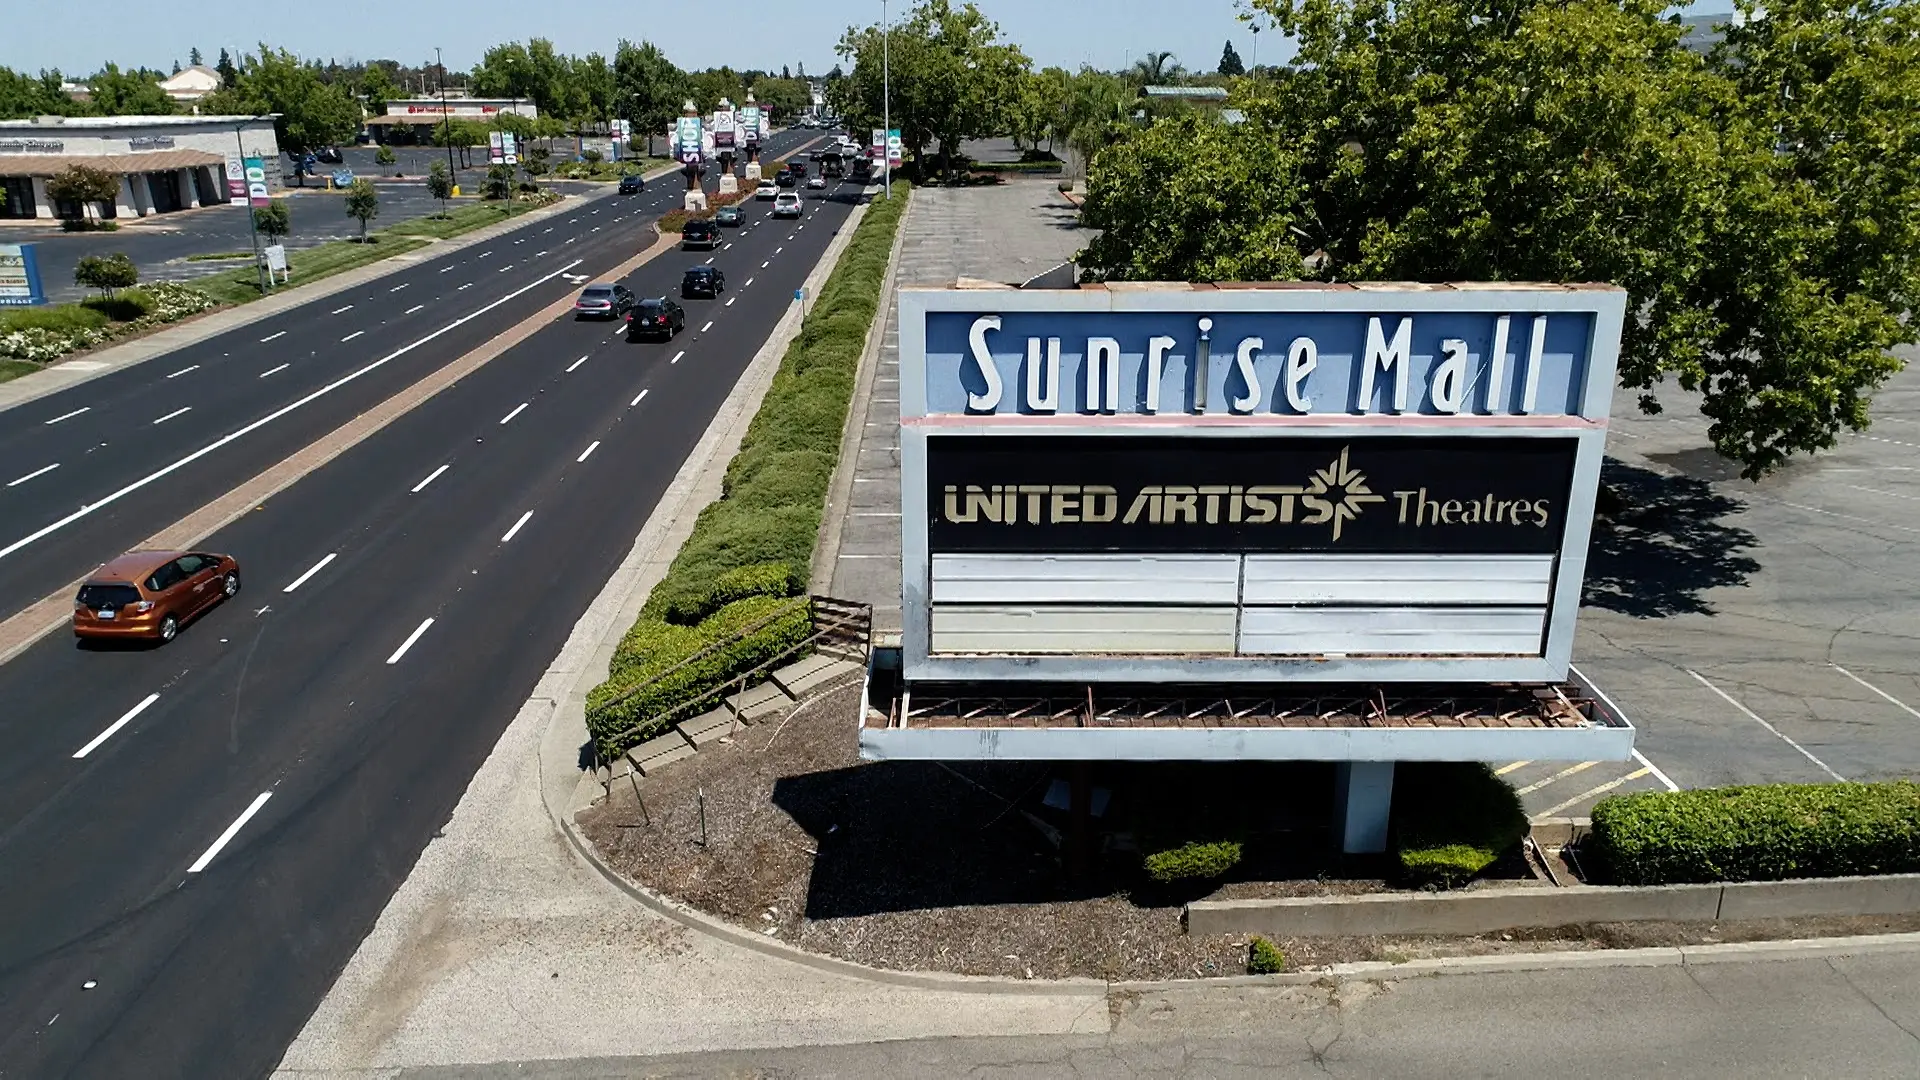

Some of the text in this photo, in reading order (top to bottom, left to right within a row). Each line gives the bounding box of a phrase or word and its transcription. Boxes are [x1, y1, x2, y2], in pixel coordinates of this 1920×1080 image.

[681, 117, 700, 163] SHOP
[968, 315, 1548, 412] Sunrise Mall
[944, 484, 1551, 528] UNITED ARTISTS Theatres
